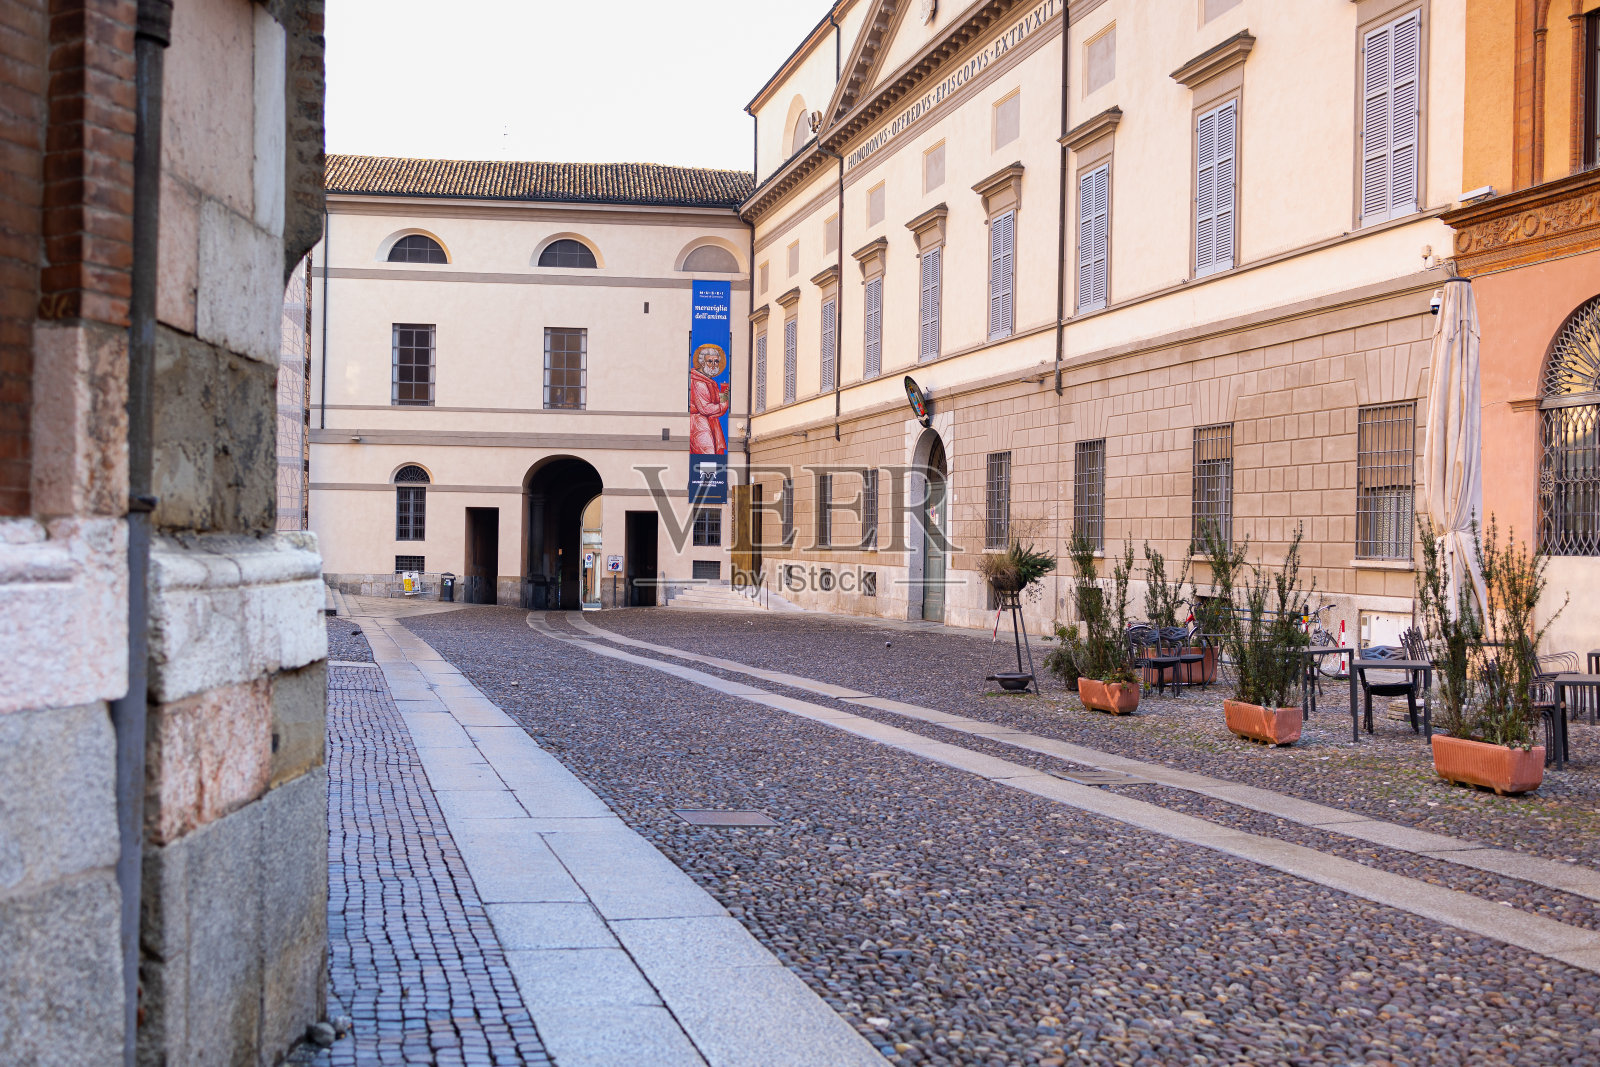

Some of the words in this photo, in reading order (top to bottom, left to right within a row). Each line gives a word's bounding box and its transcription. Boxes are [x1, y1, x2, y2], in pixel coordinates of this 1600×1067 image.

[891, 94, 931, 136] OFFREDVS
[936, 49, 988, 104] EPISCOPVS
[995, 0, 1054, 59] EXTRVXIT
